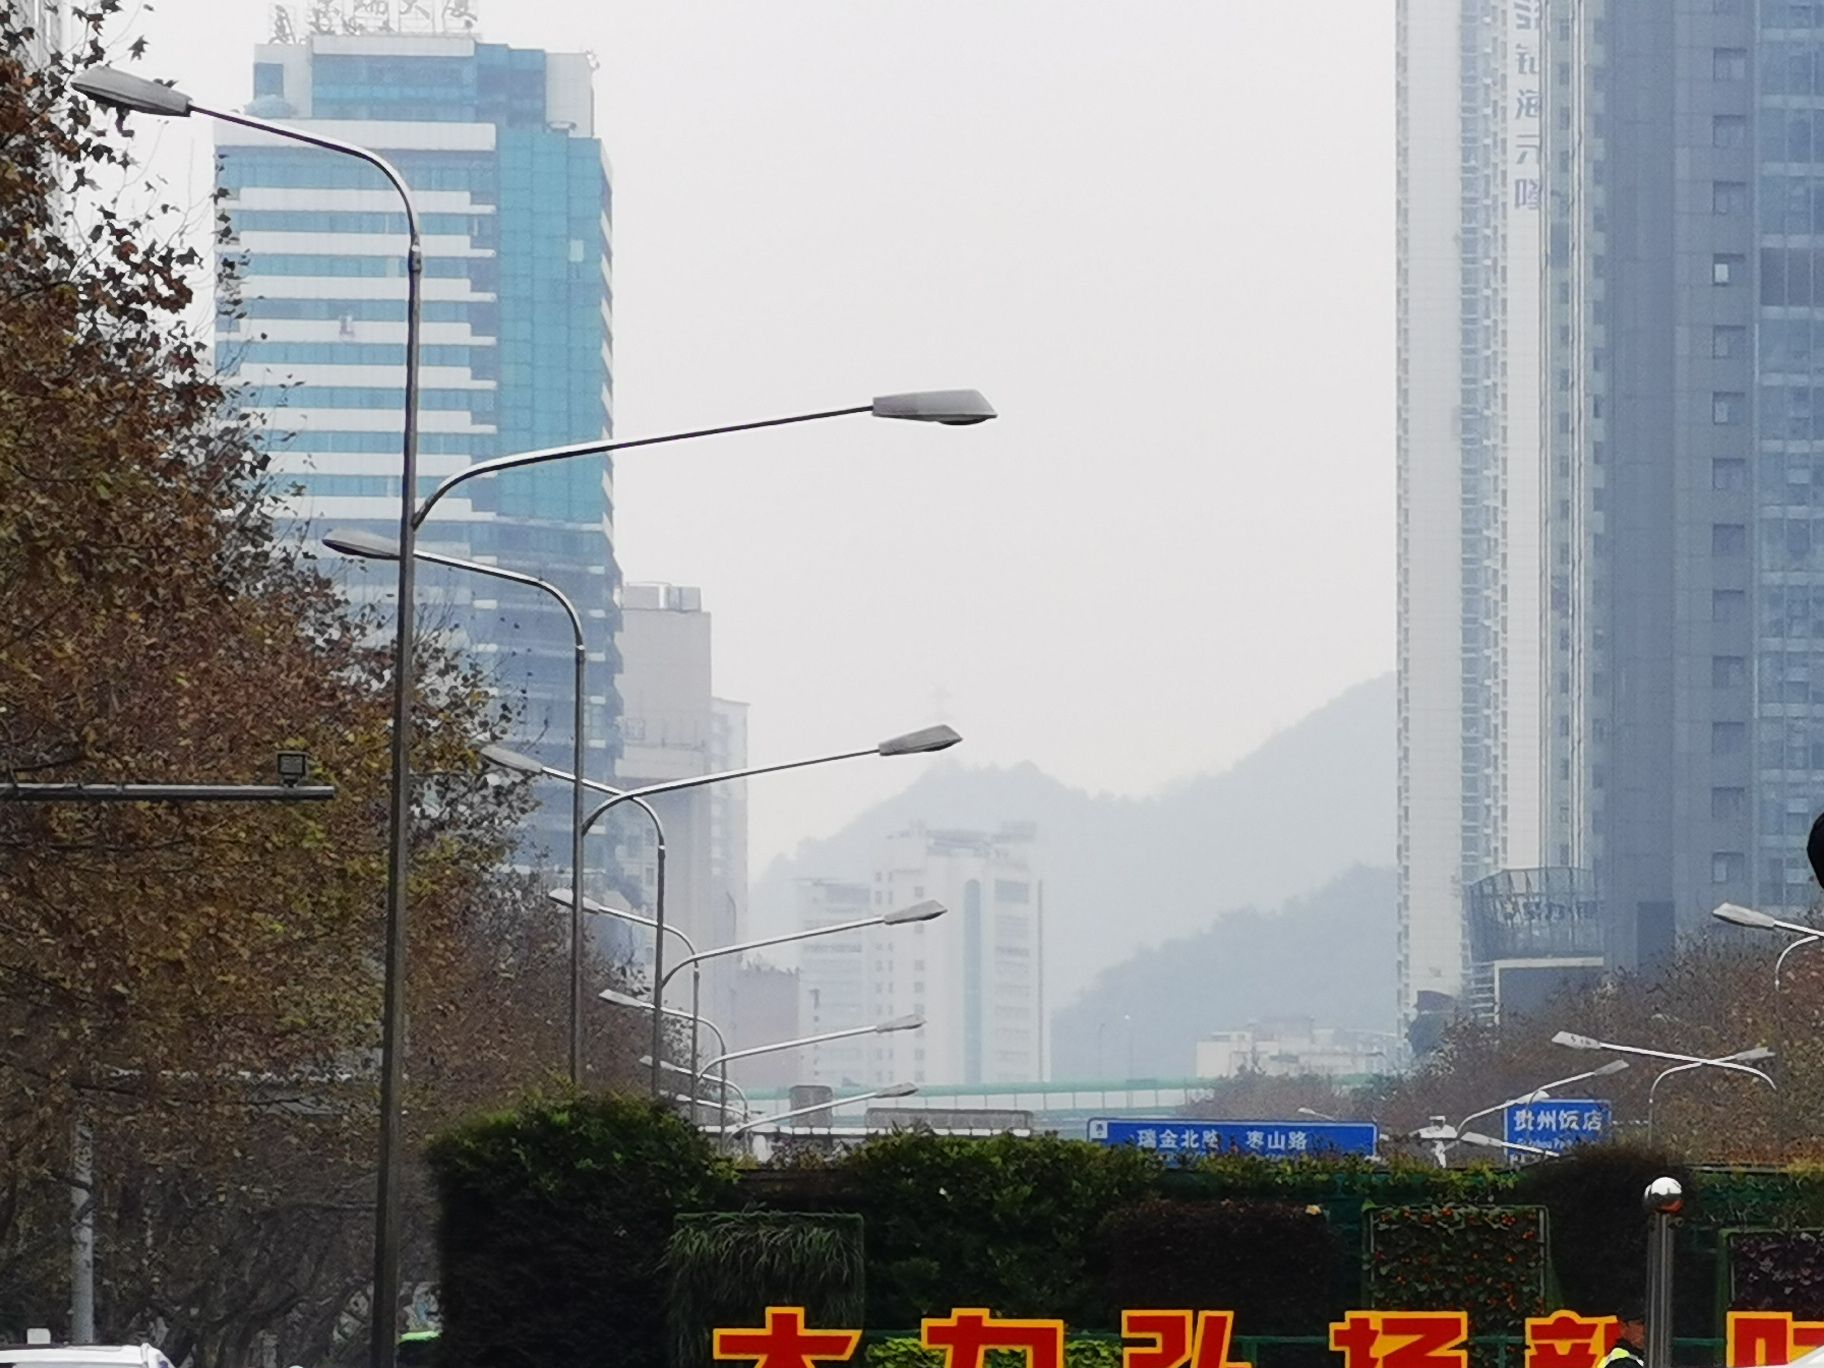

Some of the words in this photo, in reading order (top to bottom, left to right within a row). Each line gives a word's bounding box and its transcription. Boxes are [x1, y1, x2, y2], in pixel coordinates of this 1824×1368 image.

[1513, 1108, 1603, 1132] 贵州饭店
[1136, 1128, 1221, 1150] 瑞金北路
[1245, 1130, 1309, 1151] 枣山路
